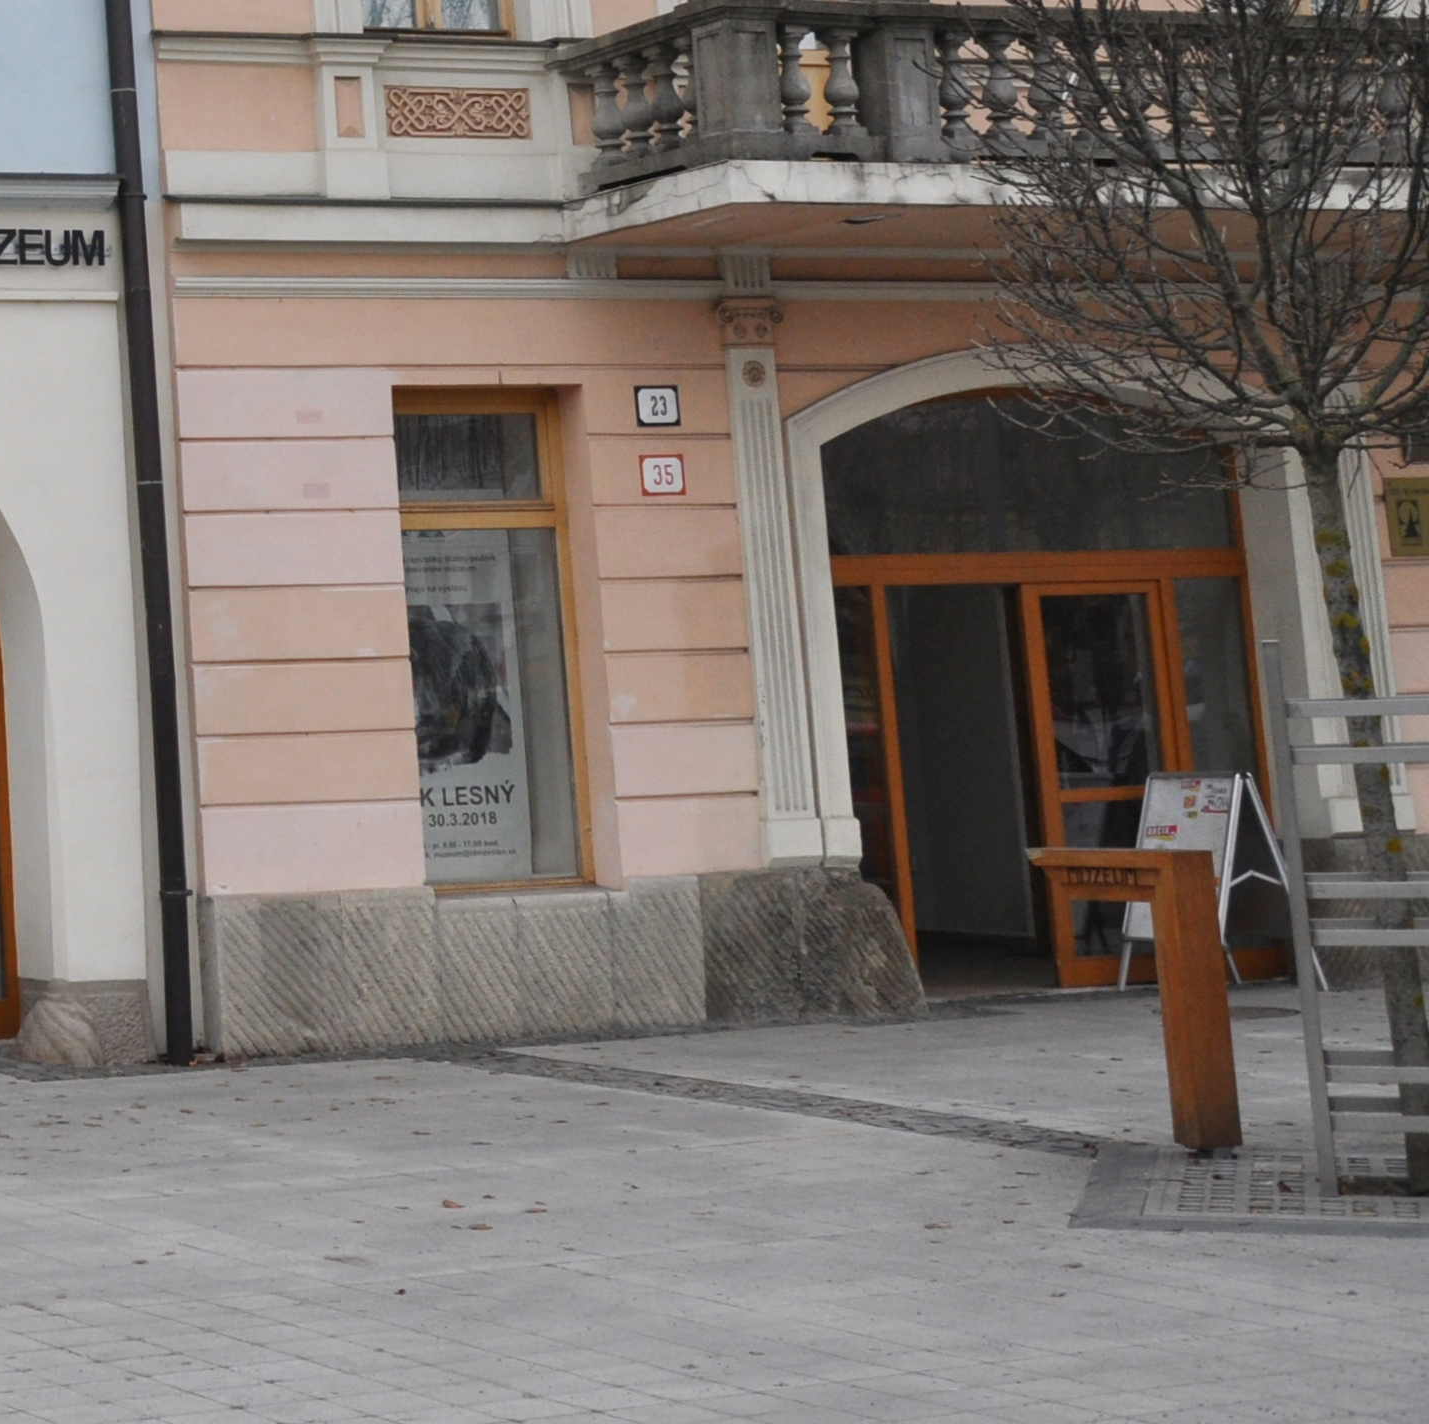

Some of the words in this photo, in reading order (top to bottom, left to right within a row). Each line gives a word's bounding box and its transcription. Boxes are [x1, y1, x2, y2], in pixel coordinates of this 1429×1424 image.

[650, 395, 668, 416] 23
[653, 464, 674, 486] 35
[442, 779, 515, 807] LESNÝ
[428, 811, 498, 827] 30.3.2018
